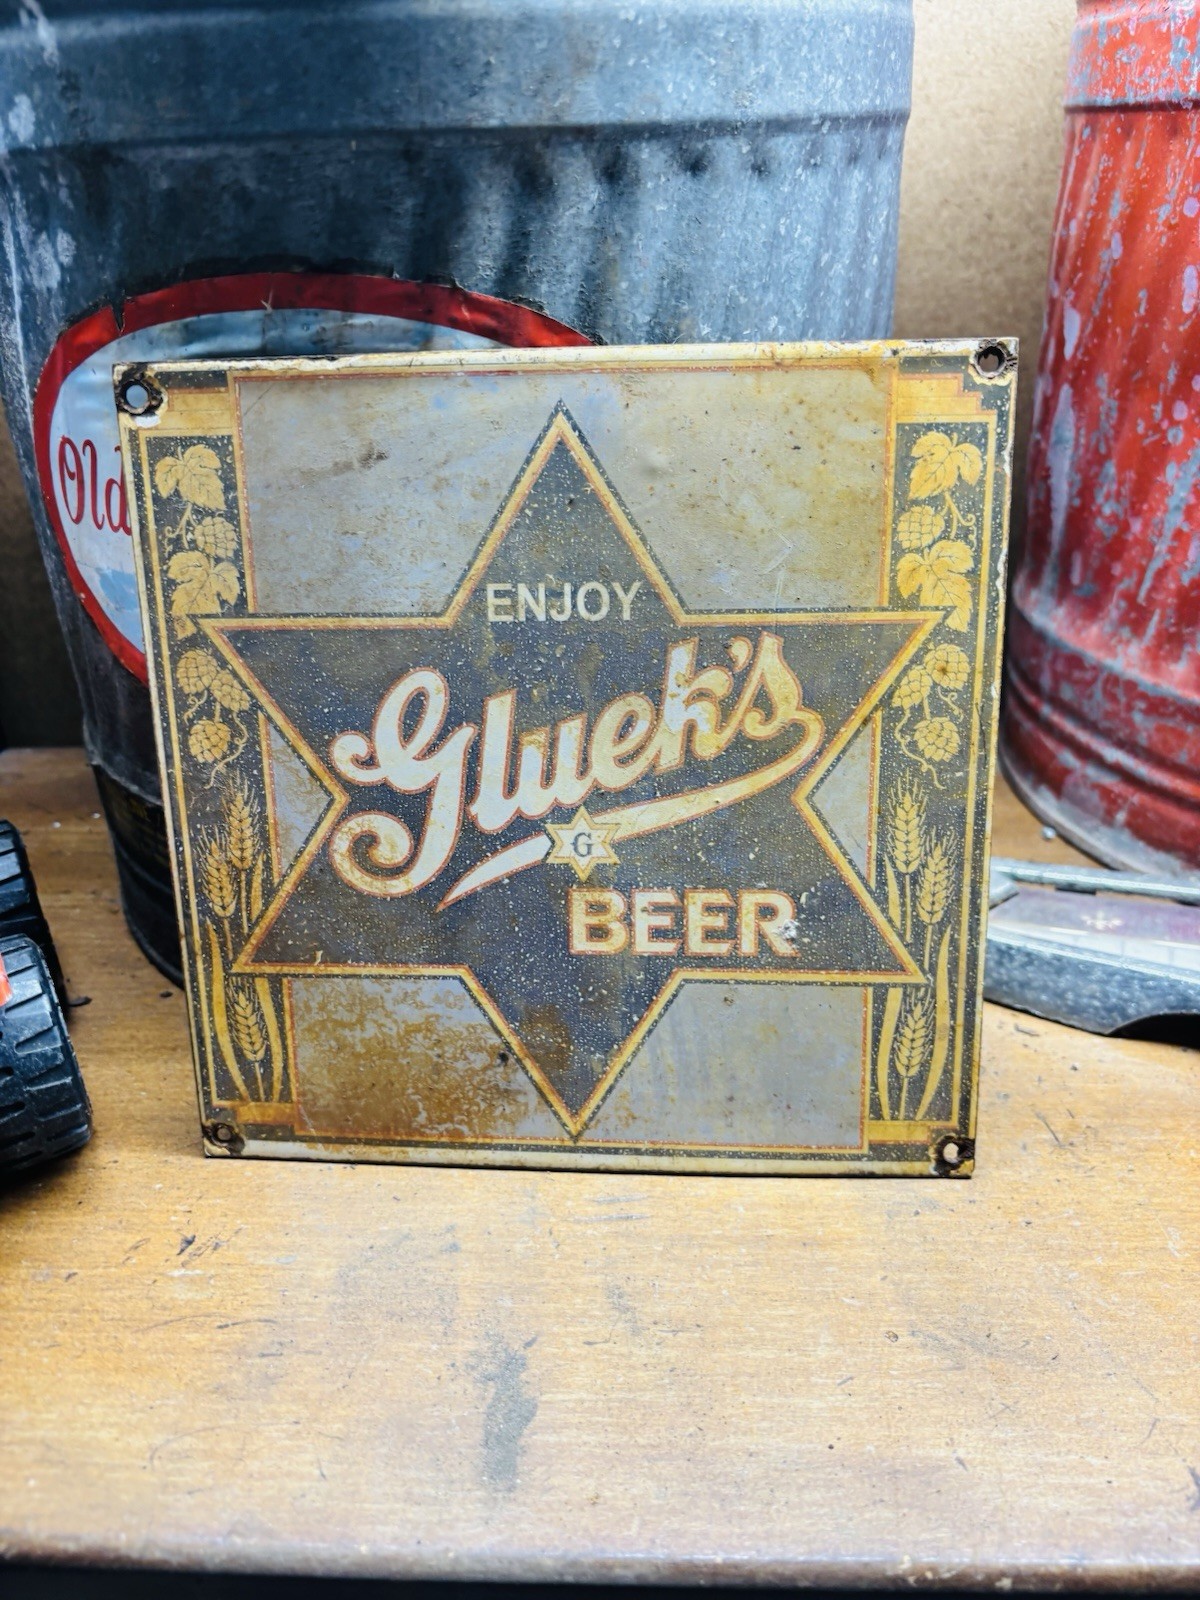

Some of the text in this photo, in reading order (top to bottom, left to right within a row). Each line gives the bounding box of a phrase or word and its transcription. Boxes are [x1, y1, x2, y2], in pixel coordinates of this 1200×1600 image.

[58, 435, 131, 536] Old
[486, 581, 641, 622] ENJOY
[329, 630, 825, 909] Gluek's
[573, 832, 594, 857] G
[567, 888, 800, 957] BEER
